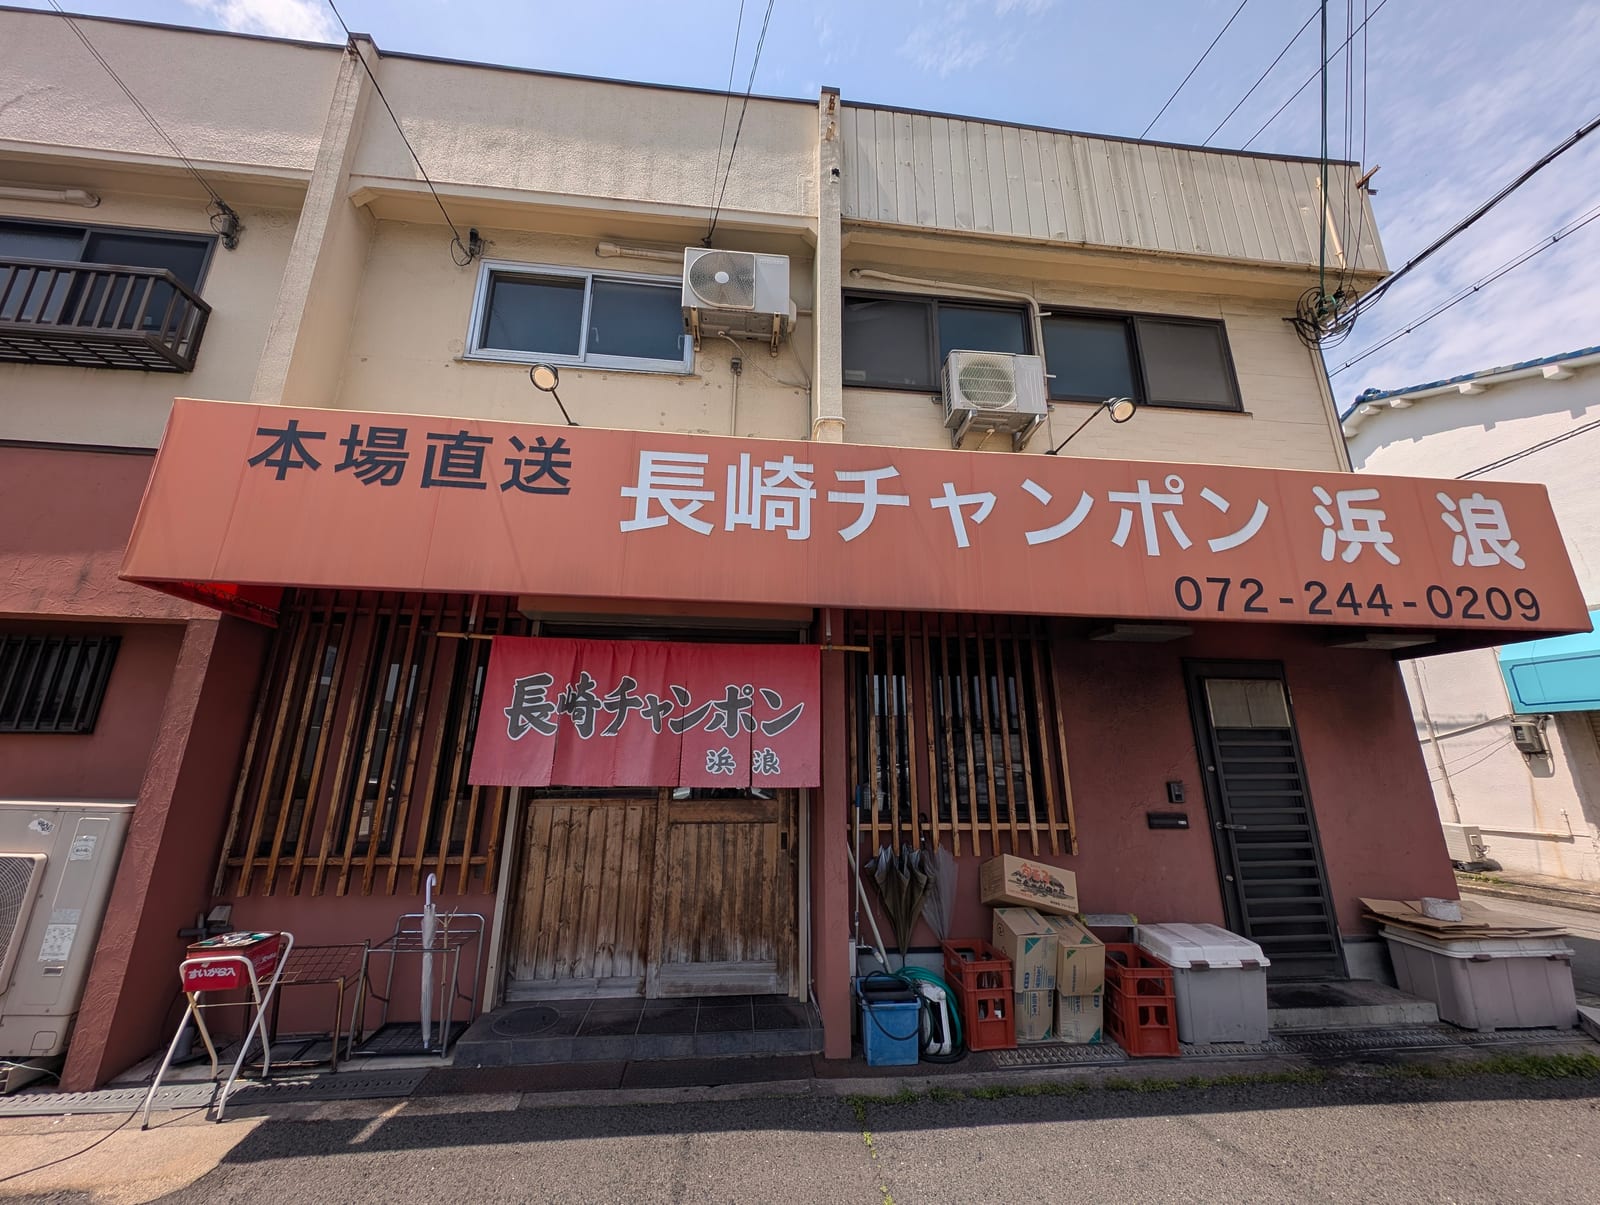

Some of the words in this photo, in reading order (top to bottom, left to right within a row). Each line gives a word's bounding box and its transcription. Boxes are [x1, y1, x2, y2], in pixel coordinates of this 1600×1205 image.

[247, 418, 573, 496] 本場直送
[619, 449, 1270, 557] 長崎チャンポン
[1173, 575, 1542, 622] 072-244-0209
[503, 670, 806, 741] 長崎チャンポン
[188, 966, 236, 980] すいがら入
